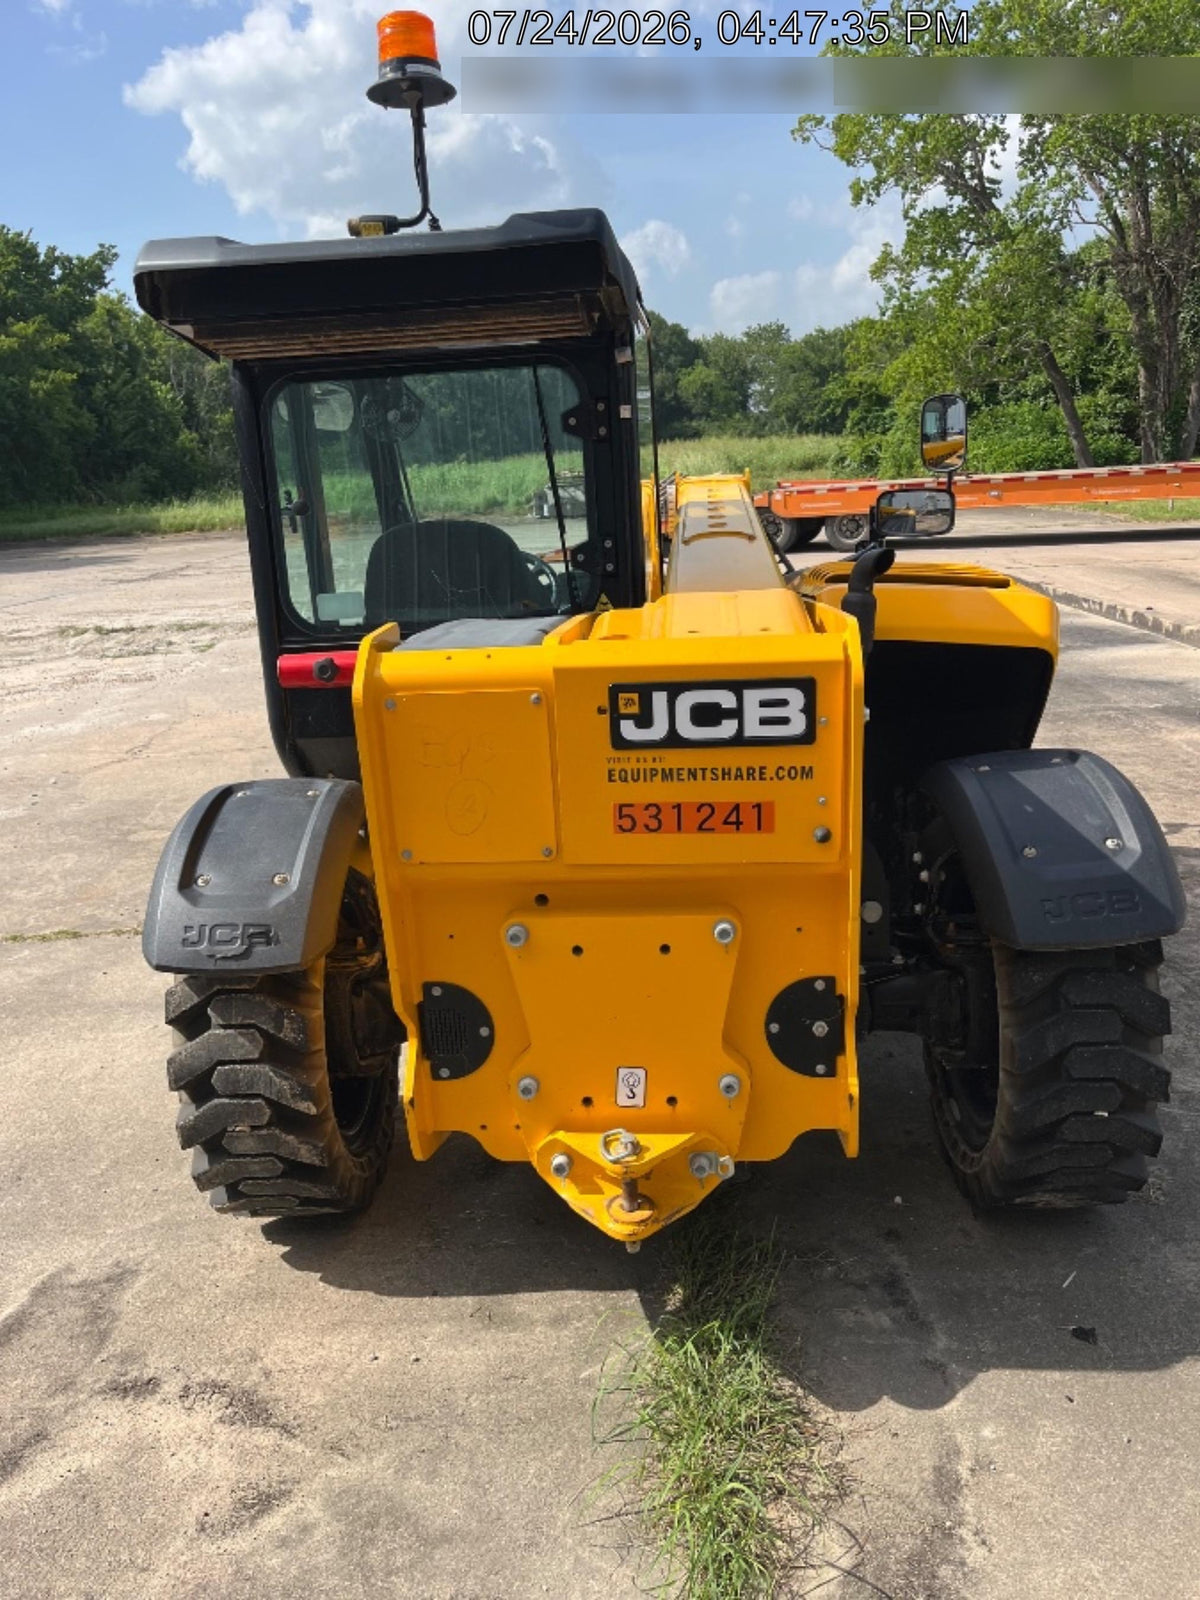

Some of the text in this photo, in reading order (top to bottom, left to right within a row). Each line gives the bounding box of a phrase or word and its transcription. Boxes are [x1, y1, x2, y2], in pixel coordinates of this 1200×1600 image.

[620, 687, 807, 741] JCB
[607, 765, 814, 783] EQUIPMENTSHARE.COM
[617, 802, 763, 833] 531241
[1042, 889, 1142, 924] JCB
